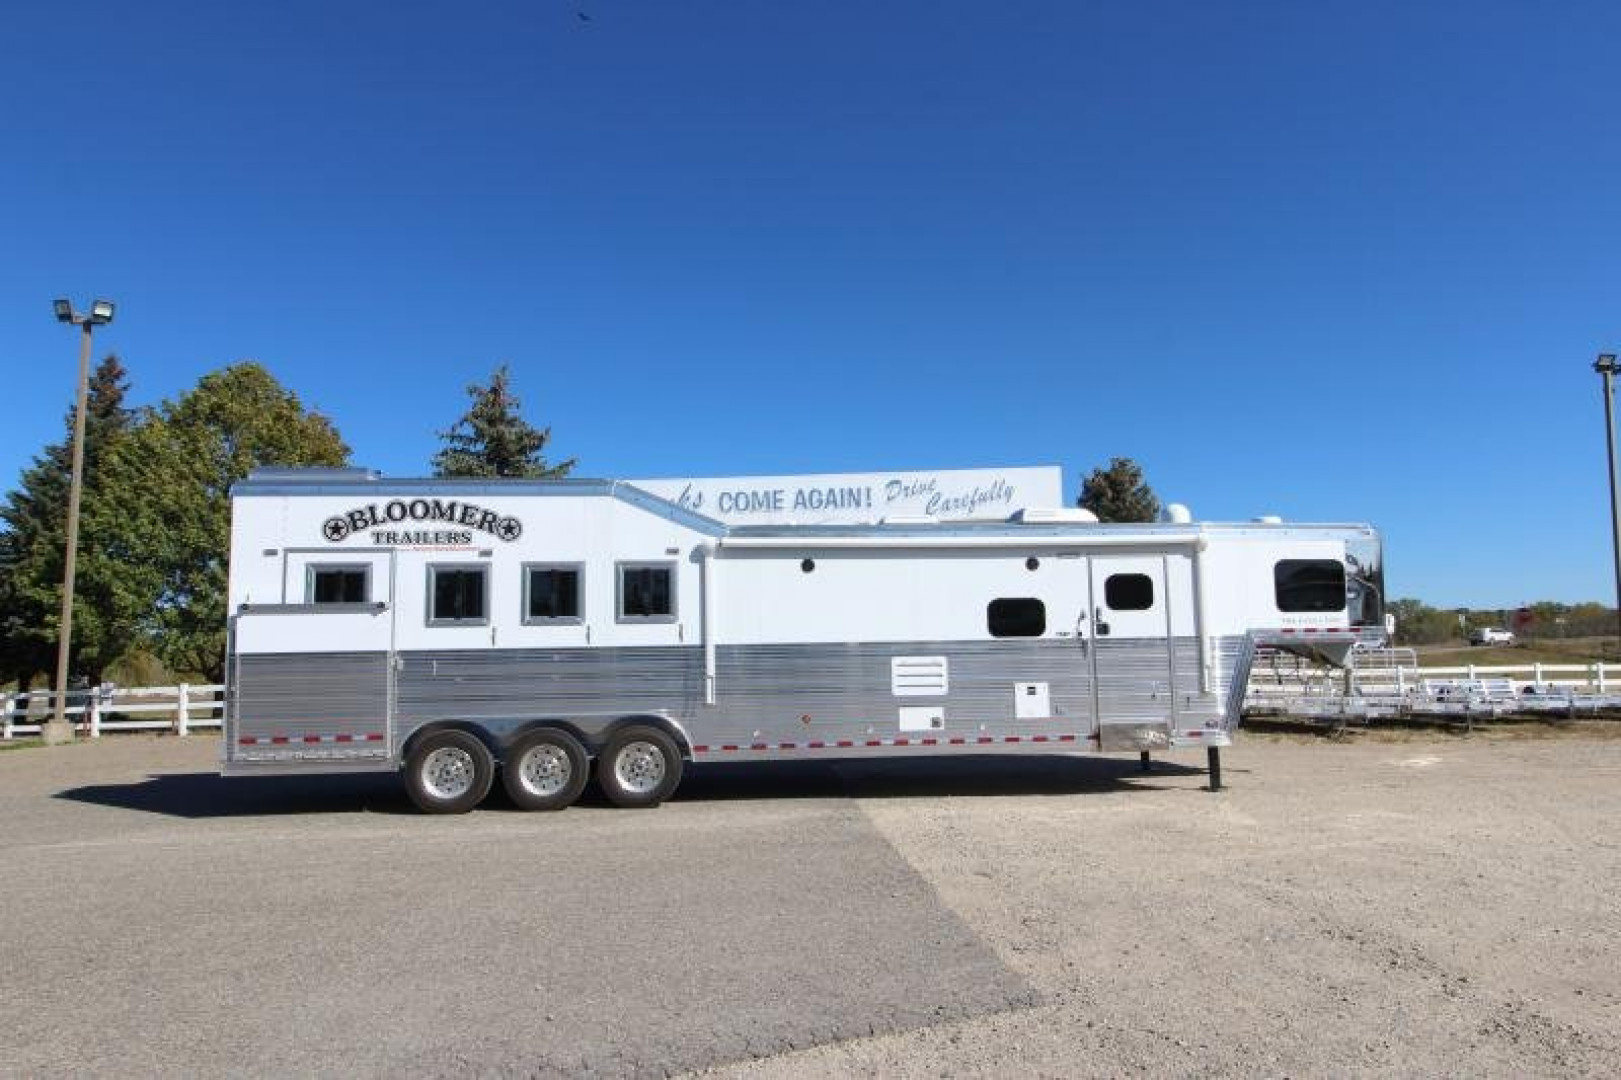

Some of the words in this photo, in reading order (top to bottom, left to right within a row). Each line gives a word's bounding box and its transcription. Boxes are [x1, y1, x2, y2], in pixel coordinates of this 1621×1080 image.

[719, 489, 785, 513] COME
[793, 487, 872, 509] AGAIN!
[885, 478, 937, 501] Drive
[925, 478, 1014, 515] Carefully
[346, 498, 499, 534] BLOOMER
[372, 530, 472, 545] TRAILERS
